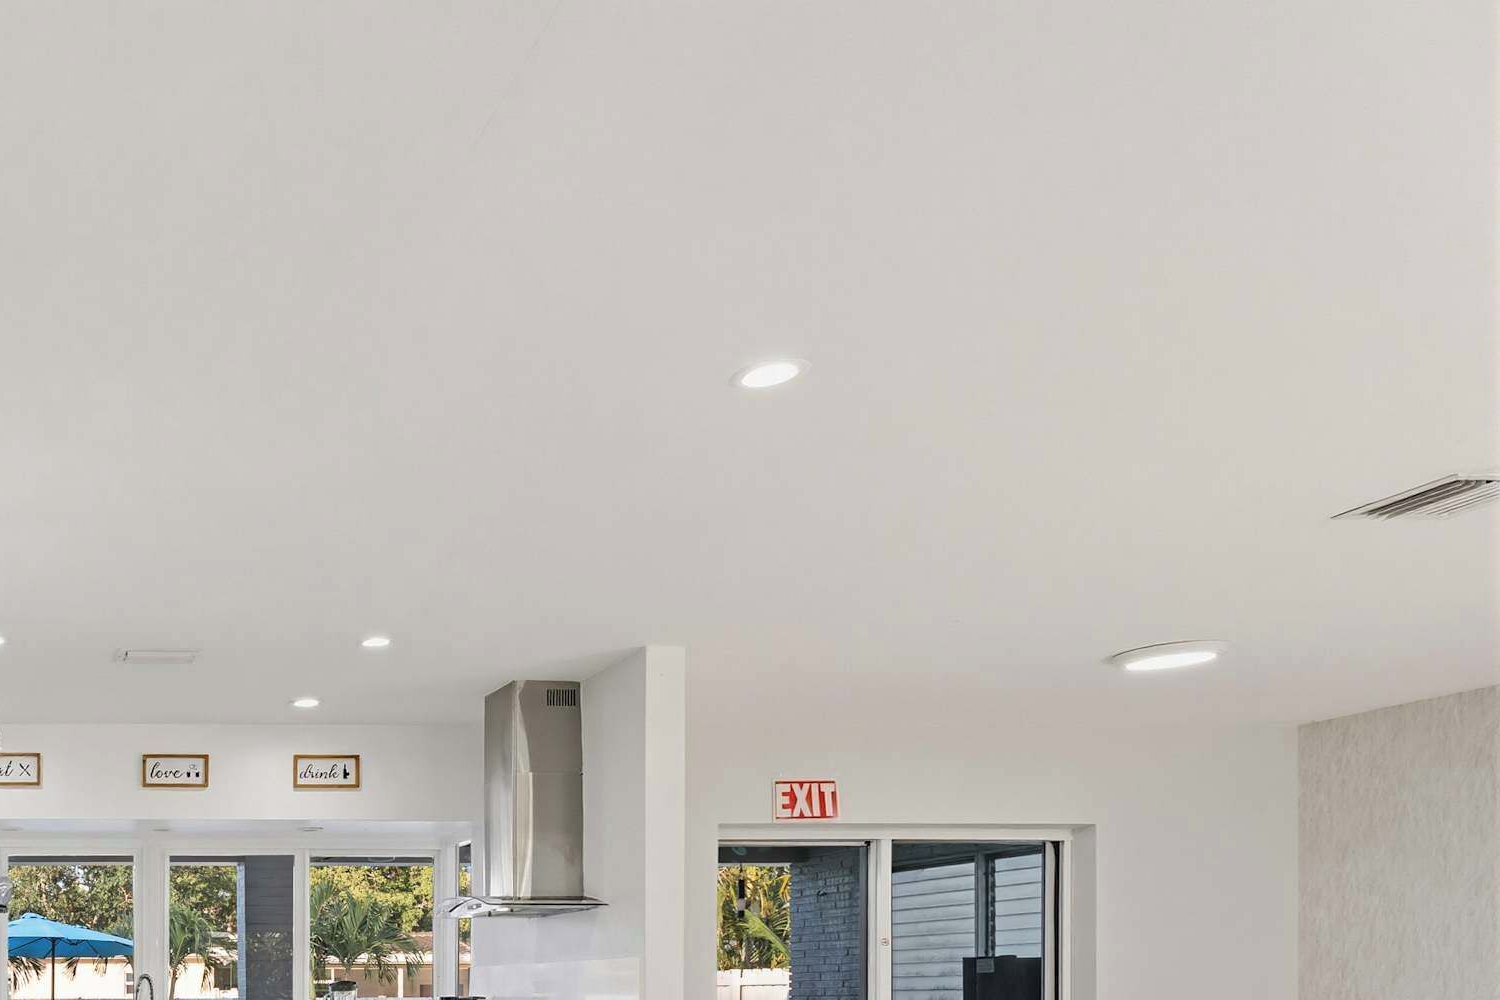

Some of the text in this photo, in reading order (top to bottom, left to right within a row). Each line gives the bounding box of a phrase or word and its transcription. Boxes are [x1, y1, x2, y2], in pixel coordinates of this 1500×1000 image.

[150, 761, 184, 778] love
[299, 763, 340, 779] drink
[775, 783, 837, 817] EXIT
